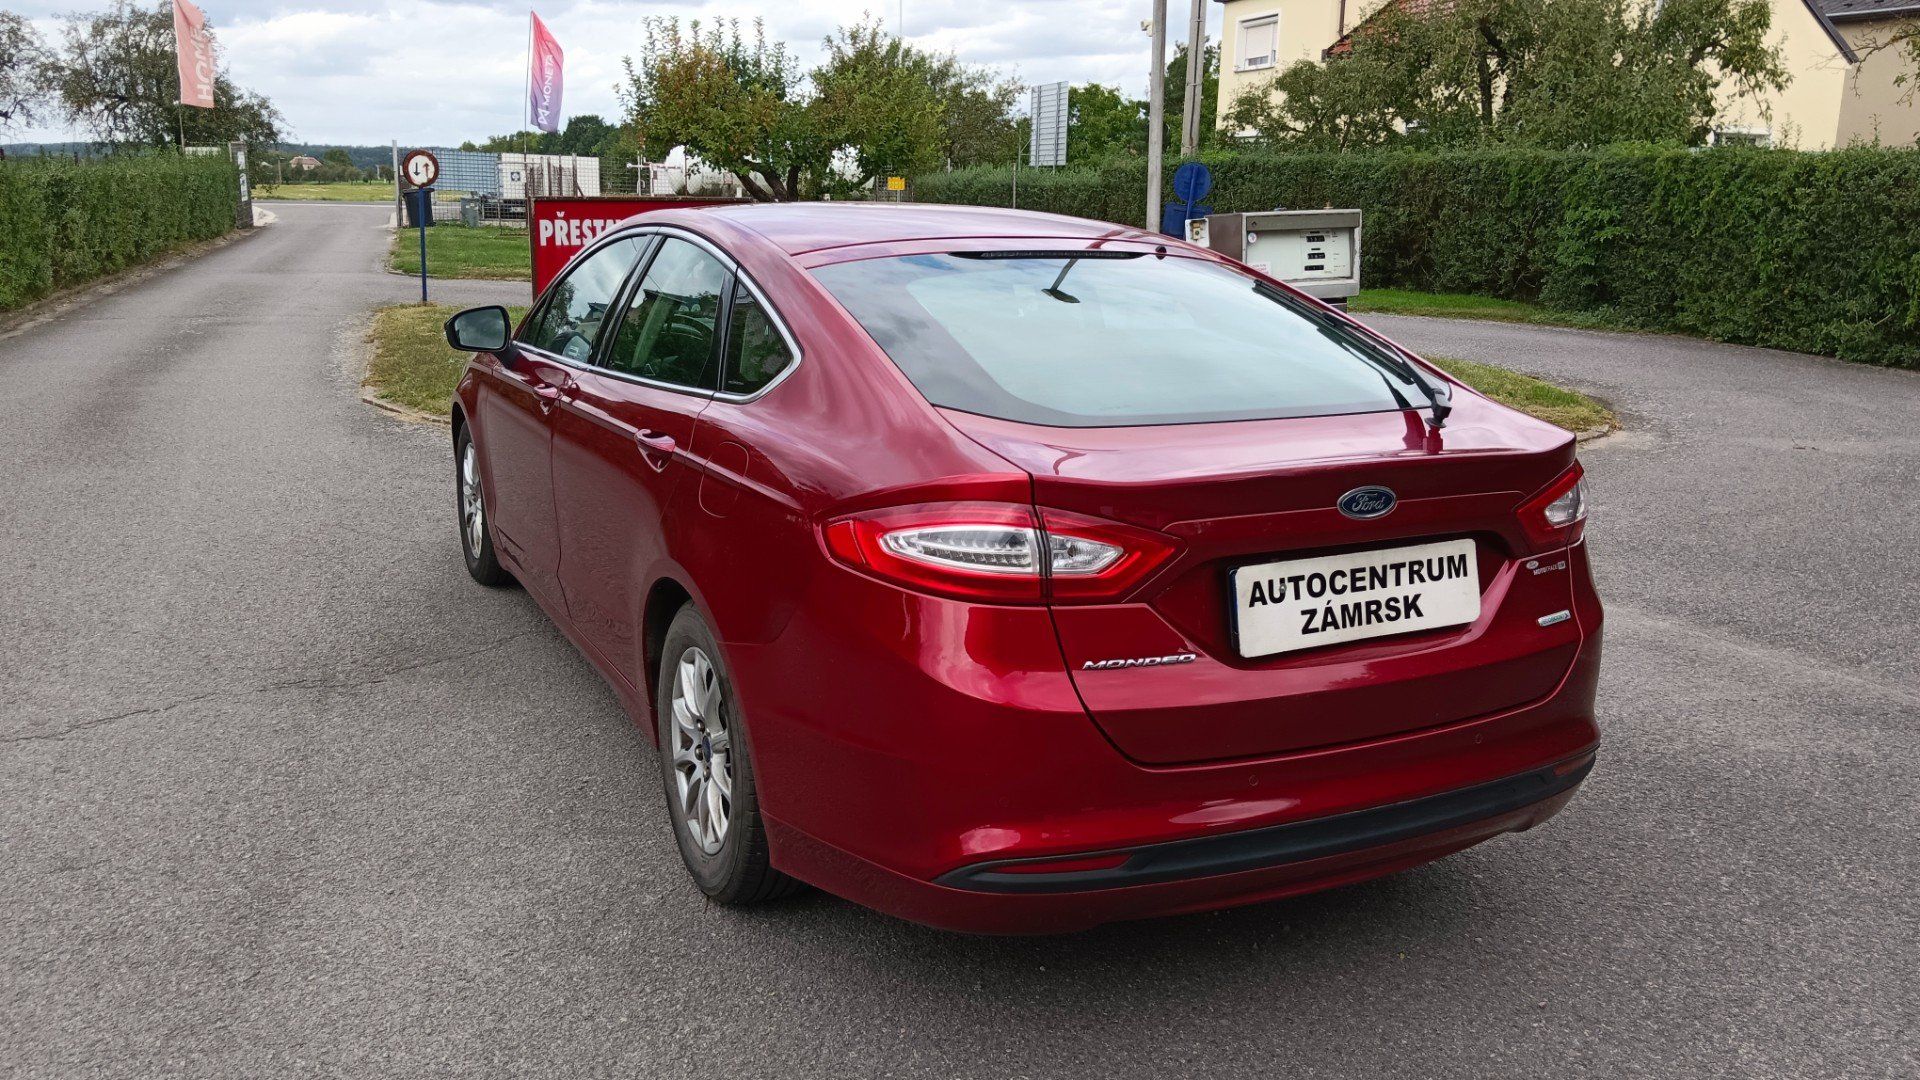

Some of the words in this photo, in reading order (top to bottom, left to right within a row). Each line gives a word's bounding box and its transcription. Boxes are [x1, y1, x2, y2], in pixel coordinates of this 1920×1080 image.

[542, 54, 554, 106] MONETA
[1352, 493, 1385, 511] Ford
[1248, 554, 1468, 608] AUTOCENTRUM
[1300, 593, 1424, 635] ZÁMRSK
[1082, 654, 1196, 670] MONDEO
